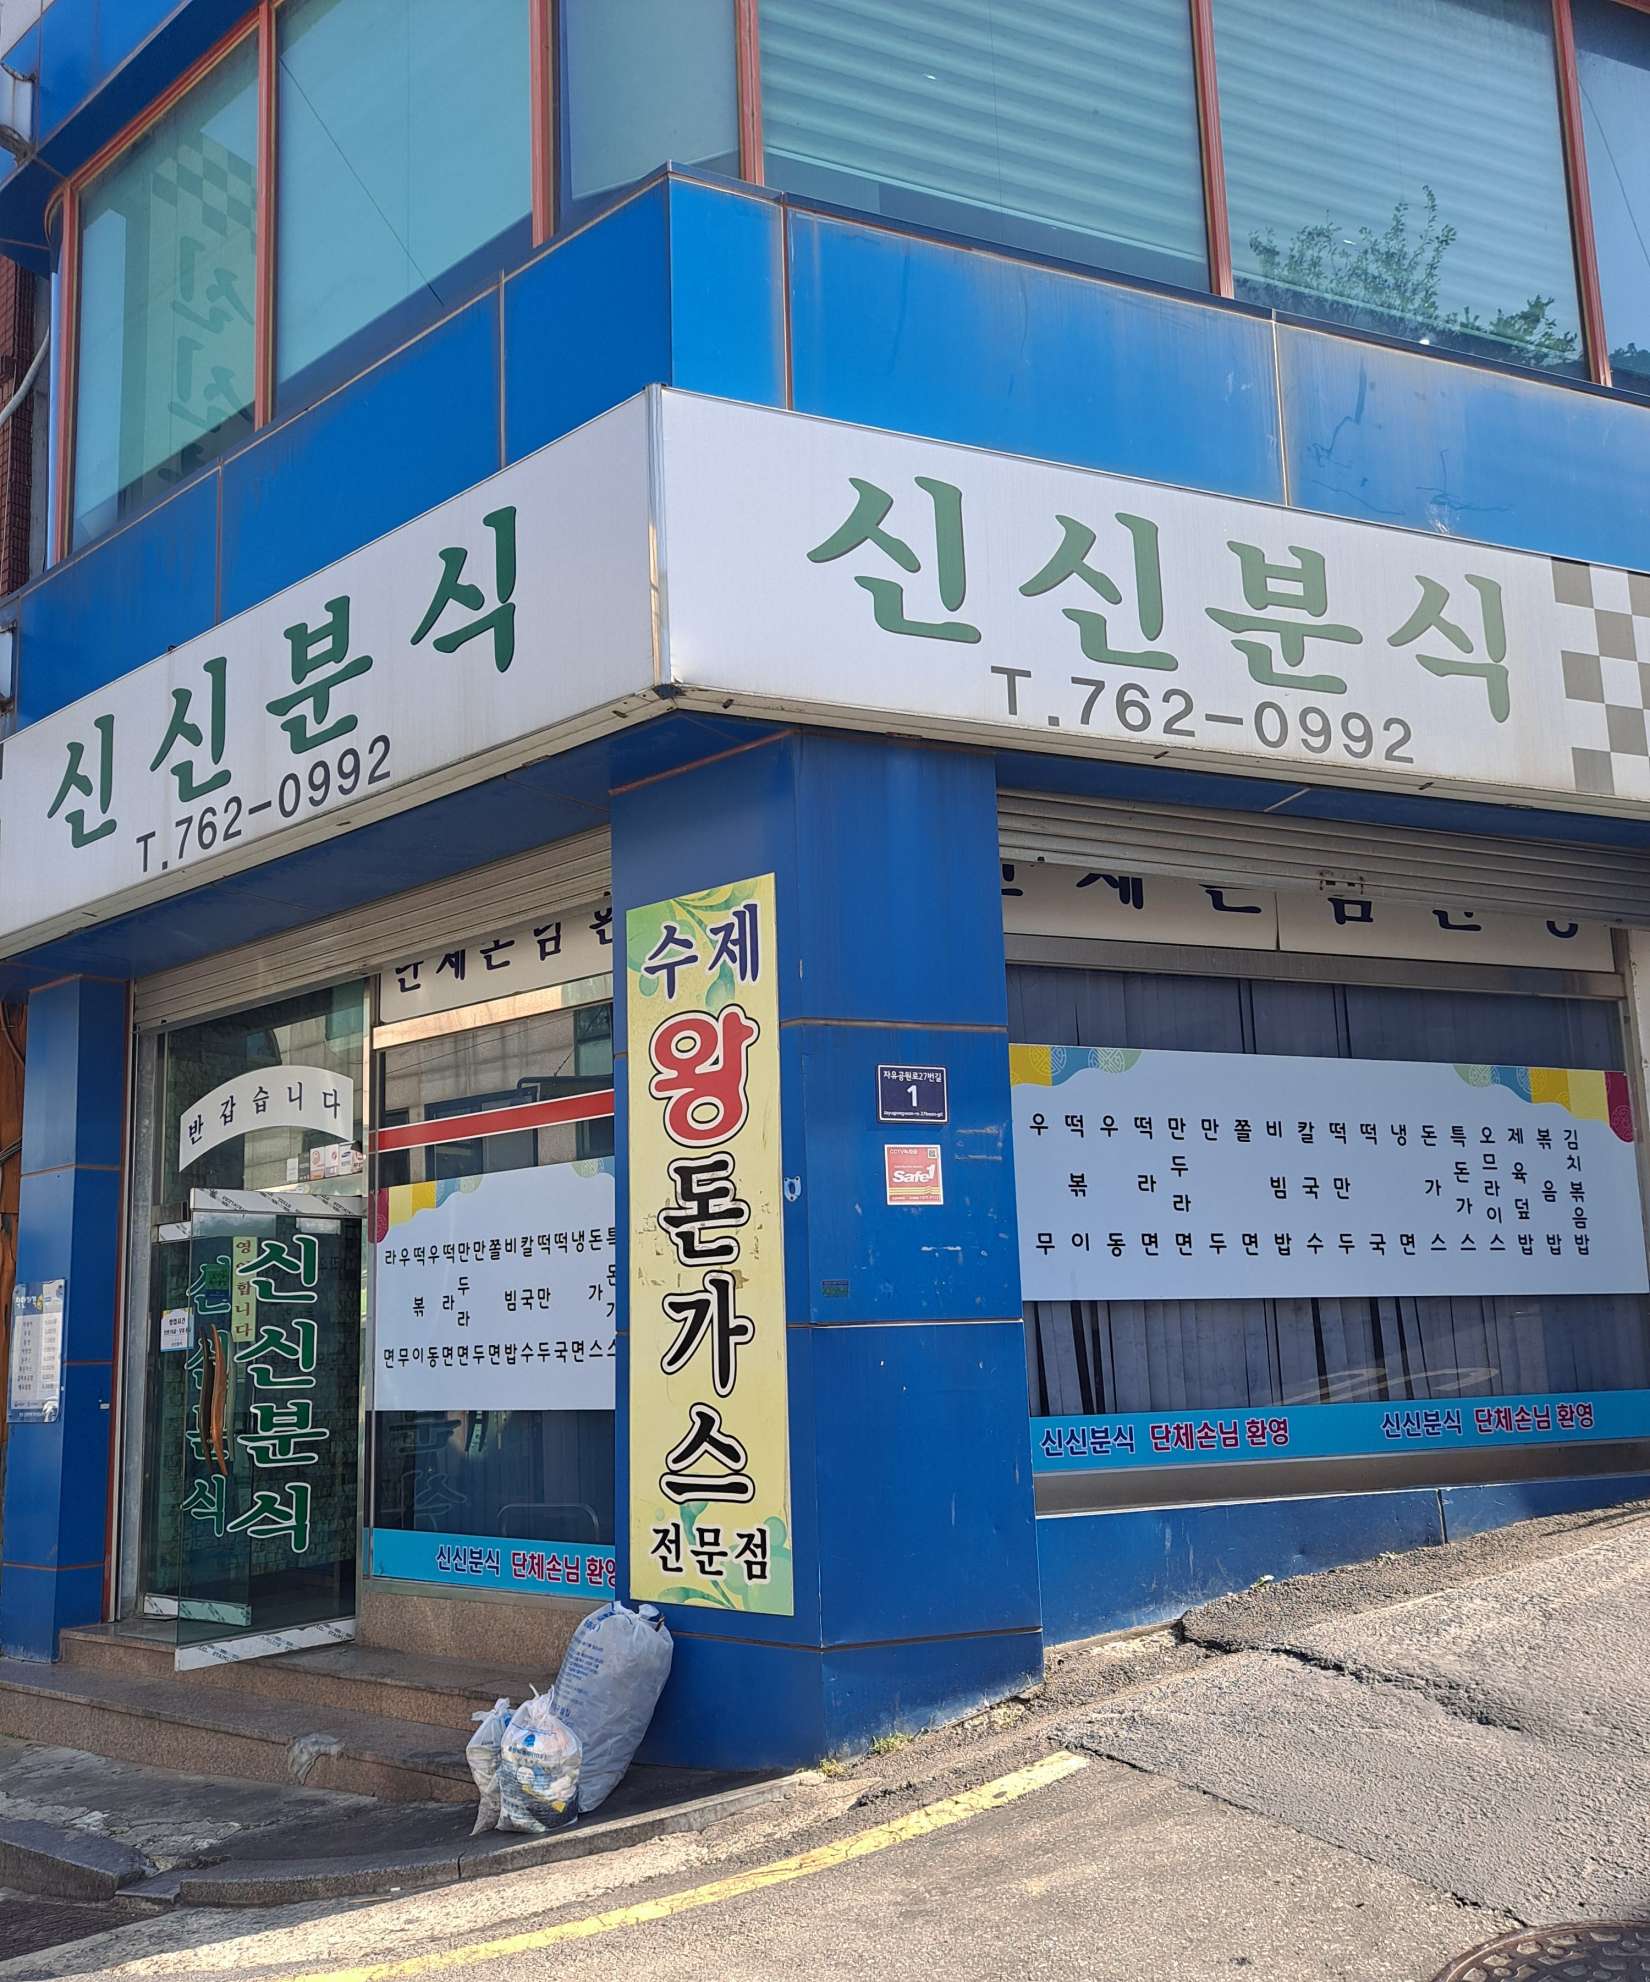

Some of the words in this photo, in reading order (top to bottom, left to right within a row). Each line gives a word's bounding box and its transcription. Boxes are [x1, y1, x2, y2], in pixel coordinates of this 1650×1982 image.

[808, 475, 1512, 723] 신신분식
[47, 505, 517, 849] 신신분식
[990, 665, 1415, 764] T.762-0992
[136, 734, 391, 872] T.762-0992
[643, 903, 759, 1000] 수제
[188, 1081, 341, 1145] 반갑습니다
[906, 1084, 918, 1107] 1
[234, 1240, 252, 1337] 영합니다
[648, 1003, 761, 1504] 왕돈가스
[227, 1234, 328, 1553] 신신분식
[1040, 1425, 1135, 1457] 신신분식
[1150, 1418, 1239, 1453] 단체손님
[1246, 1417, 1289, 1447] 환영
[1382, 1409, 1463, 1439] 신신분식
[1474, 1404, 1550, 1434] 단체손님
[1557, 1402, 1593, 1430] 환영
[436, 1545, 500, 1576] 신신분식
[511, 1551, 580, 1584] 단체손님
[650, 1521, 769, 1580] 전문점
